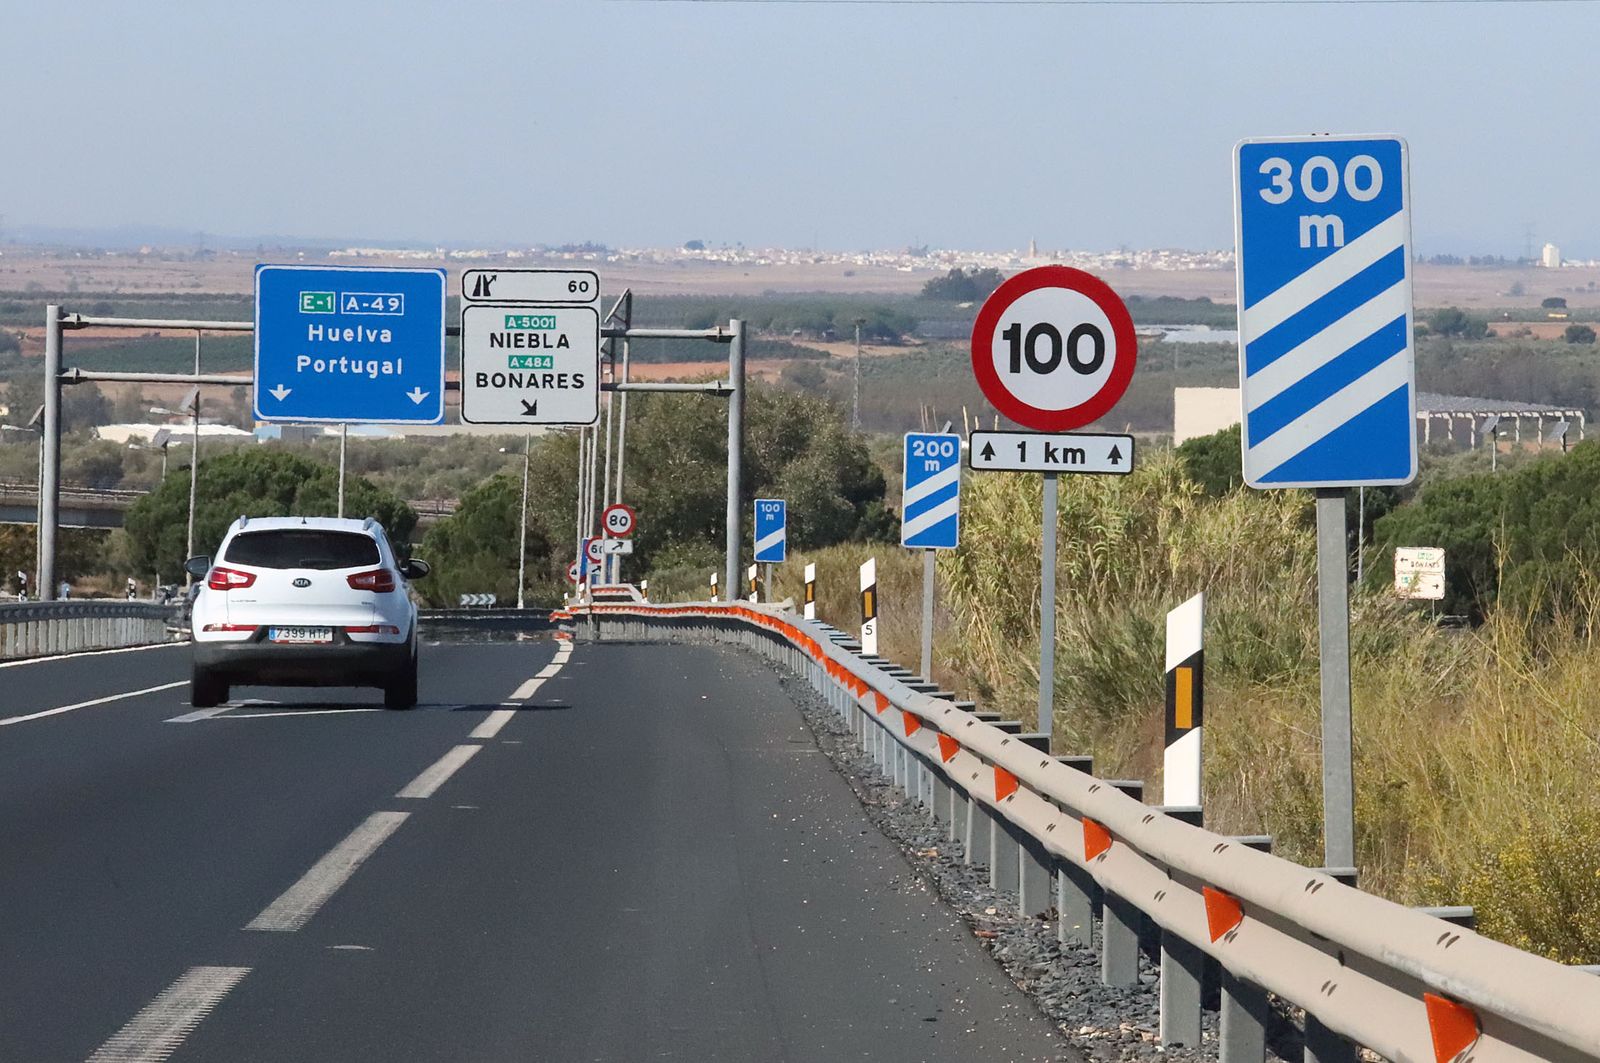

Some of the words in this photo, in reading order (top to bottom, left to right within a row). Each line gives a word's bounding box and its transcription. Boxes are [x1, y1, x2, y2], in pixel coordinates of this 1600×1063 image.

[1259, 154, 1383, 204] 300
[1300, 214, 1345, 248] m
[568, 280, 589, 293] 60
[303, 295, 332, 310] E-1
[346, 297, 400, 311] A-49
[507, 317, 555, 328] A-5001
[308, 324, 392, 343] Huelva
[490, 333, 570, 349] NIEBLA
[1002, 322, 1106, 375] 100
[296, 355, 402, 379] Portugal
[510, 357, 552, 368] A-484
[476, 373, 585, 389] BONARES
[912, 440, 954, 458] 200
[1017, 441, 1026, 463] 1
[1044, 442, 1086, 464] km
[924, 460, 940, 472] m
[761, 504, 780, 512] 100
[609, 515, 628, 526] 80
[276, 628, 305, 639] 7399
[309, 629, 329, 639] HTP
[865, 624, 873, 636] 5
